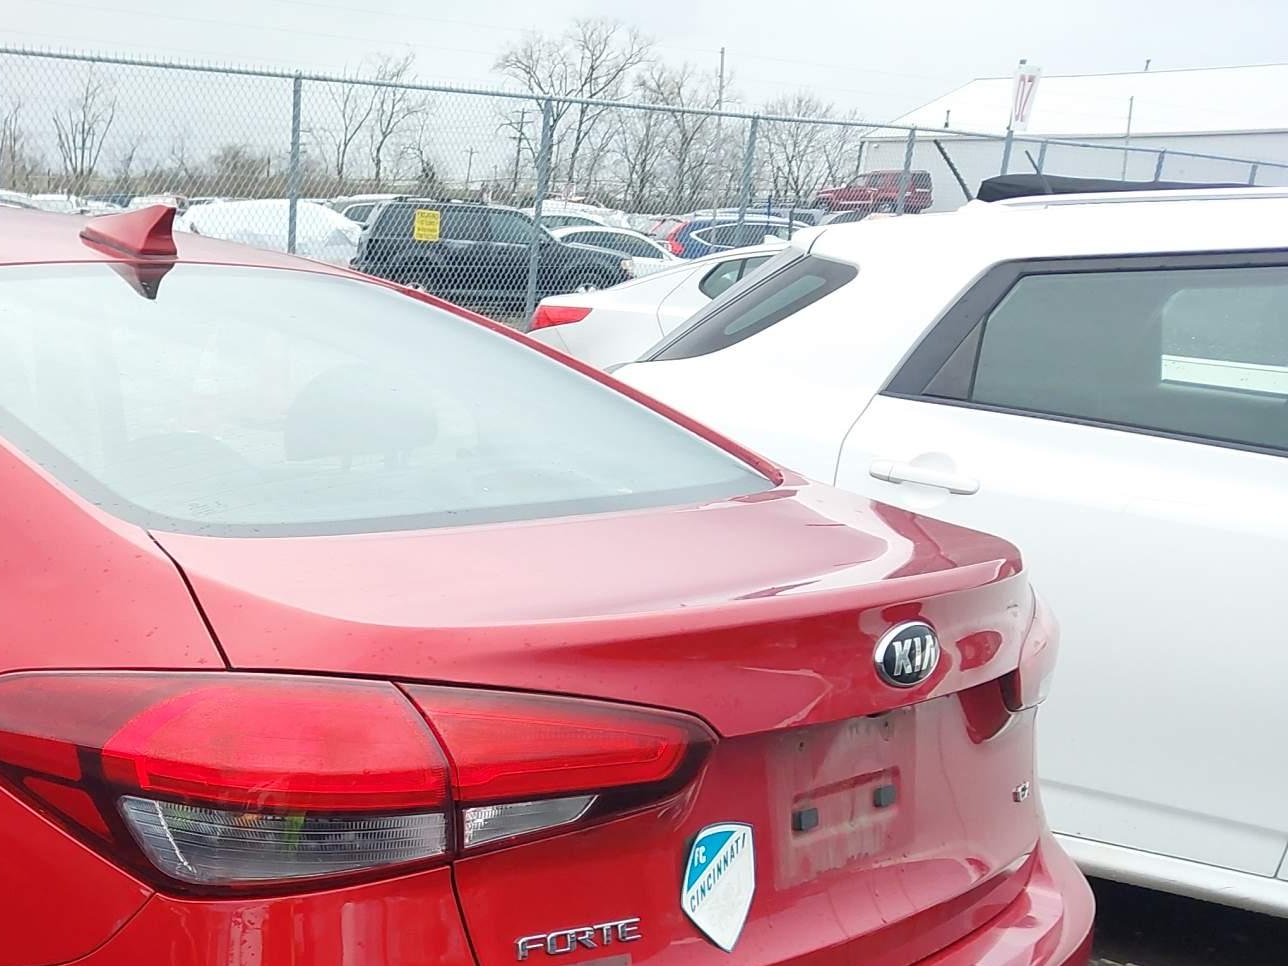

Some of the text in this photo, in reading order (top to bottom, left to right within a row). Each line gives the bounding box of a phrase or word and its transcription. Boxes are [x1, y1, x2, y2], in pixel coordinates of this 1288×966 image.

[892, 634, 936, 676] KIA
[690, 832, 747, 912] CINCINNATI
[515, 917, 642, 961] FORTE
